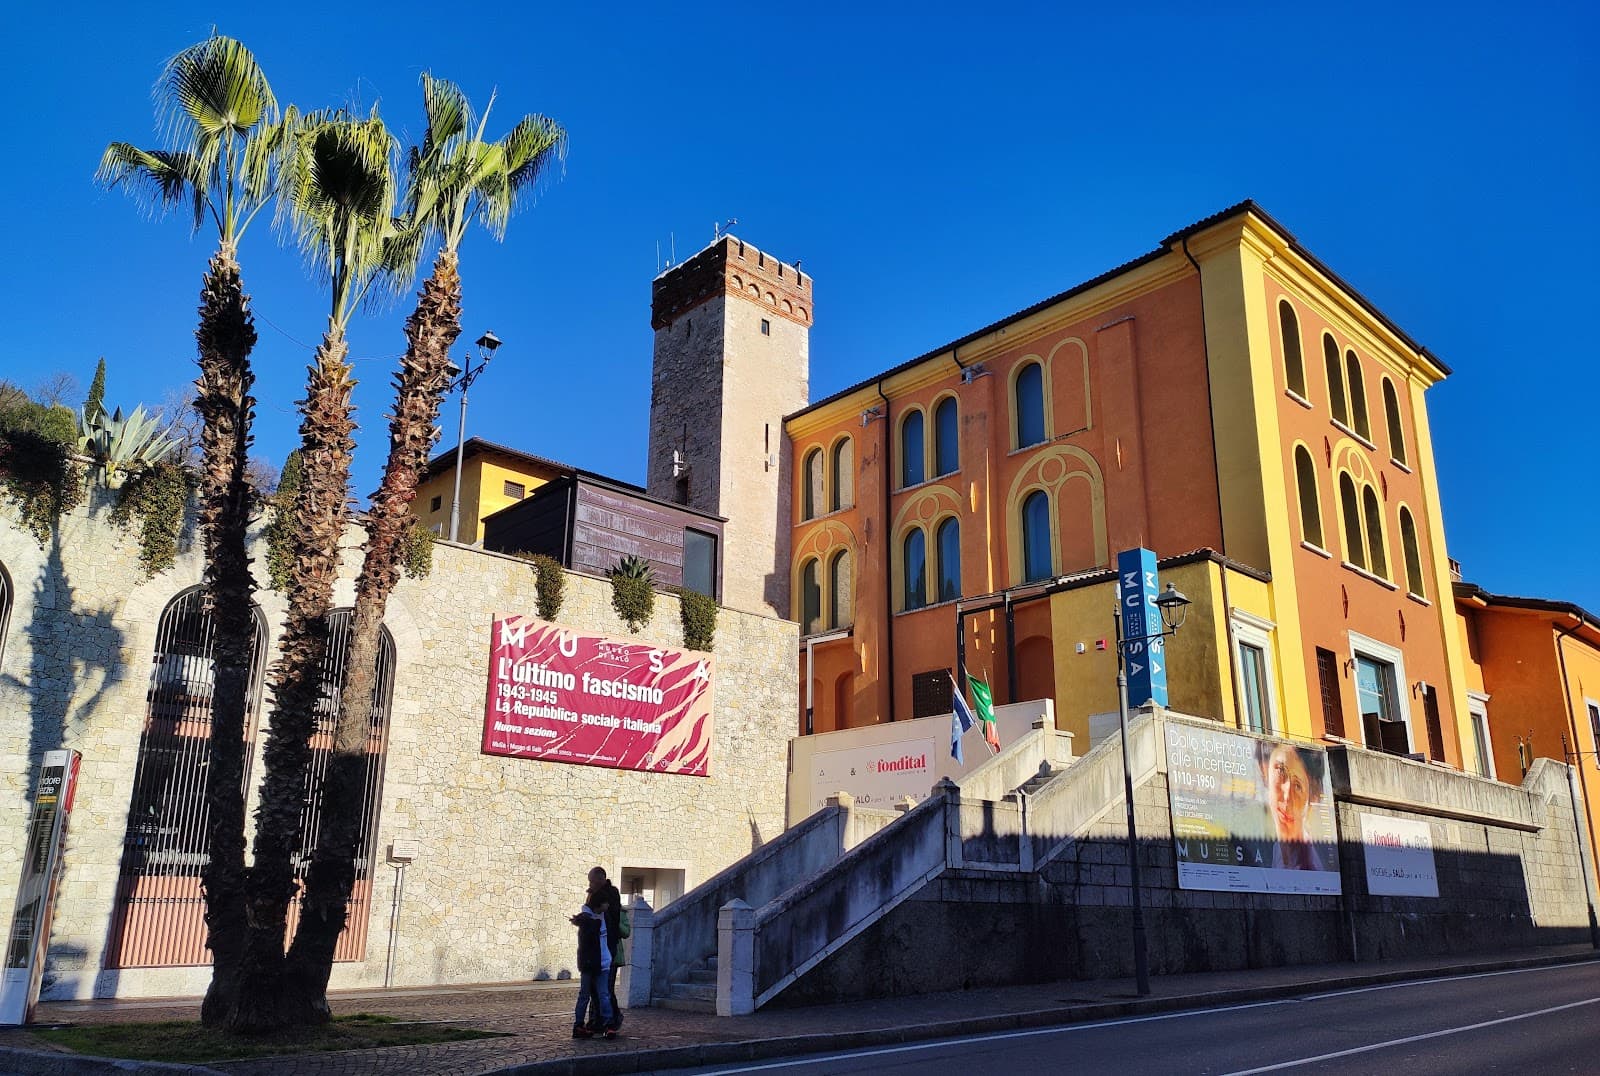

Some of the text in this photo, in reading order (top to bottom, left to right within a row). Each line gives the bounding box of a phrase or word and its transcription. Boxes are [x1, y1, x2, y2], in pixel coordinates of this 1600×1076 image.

[598, 644, 630, 655] MUSEO
[498, 656, 664, 705] L'ultimo fascismo
[497, 683, 558, 705] 1943-1945
[495, 698, 662, 734] La Repubblica sociale italiana
[493, 720, 558, 739] Nuova sezione
[1169, 729, 1253, 760] Dallo splendore
[877, 754, 927, 773] fondital
[1171, 749, 1247, 776] alle incertezze
